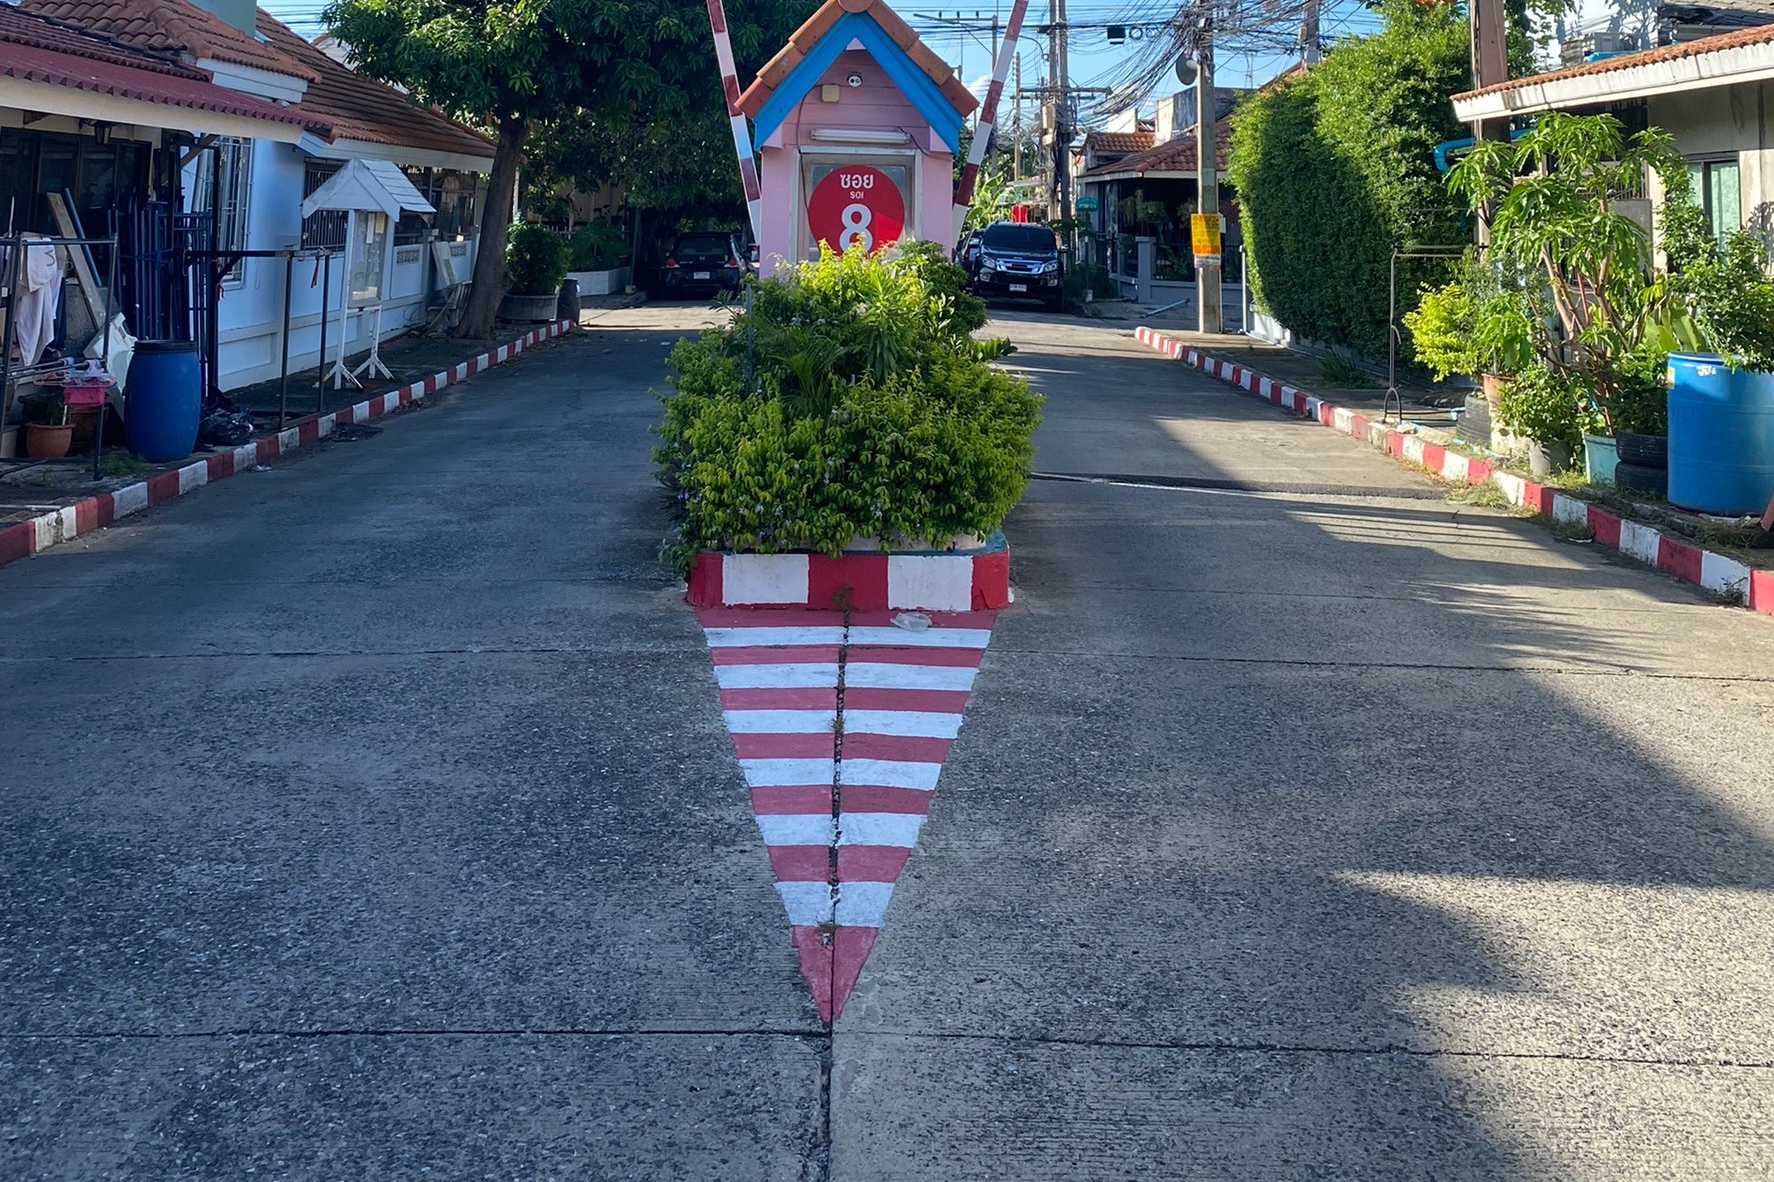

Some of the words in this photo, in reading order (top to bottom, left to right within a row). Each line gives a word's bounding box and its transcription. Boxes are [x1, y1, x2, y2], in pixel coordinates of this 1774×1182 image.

[840, 174, 874, 189] ซอย
[850, 190, 864, 199] SOI
[839, 203, 873, 254] 8
